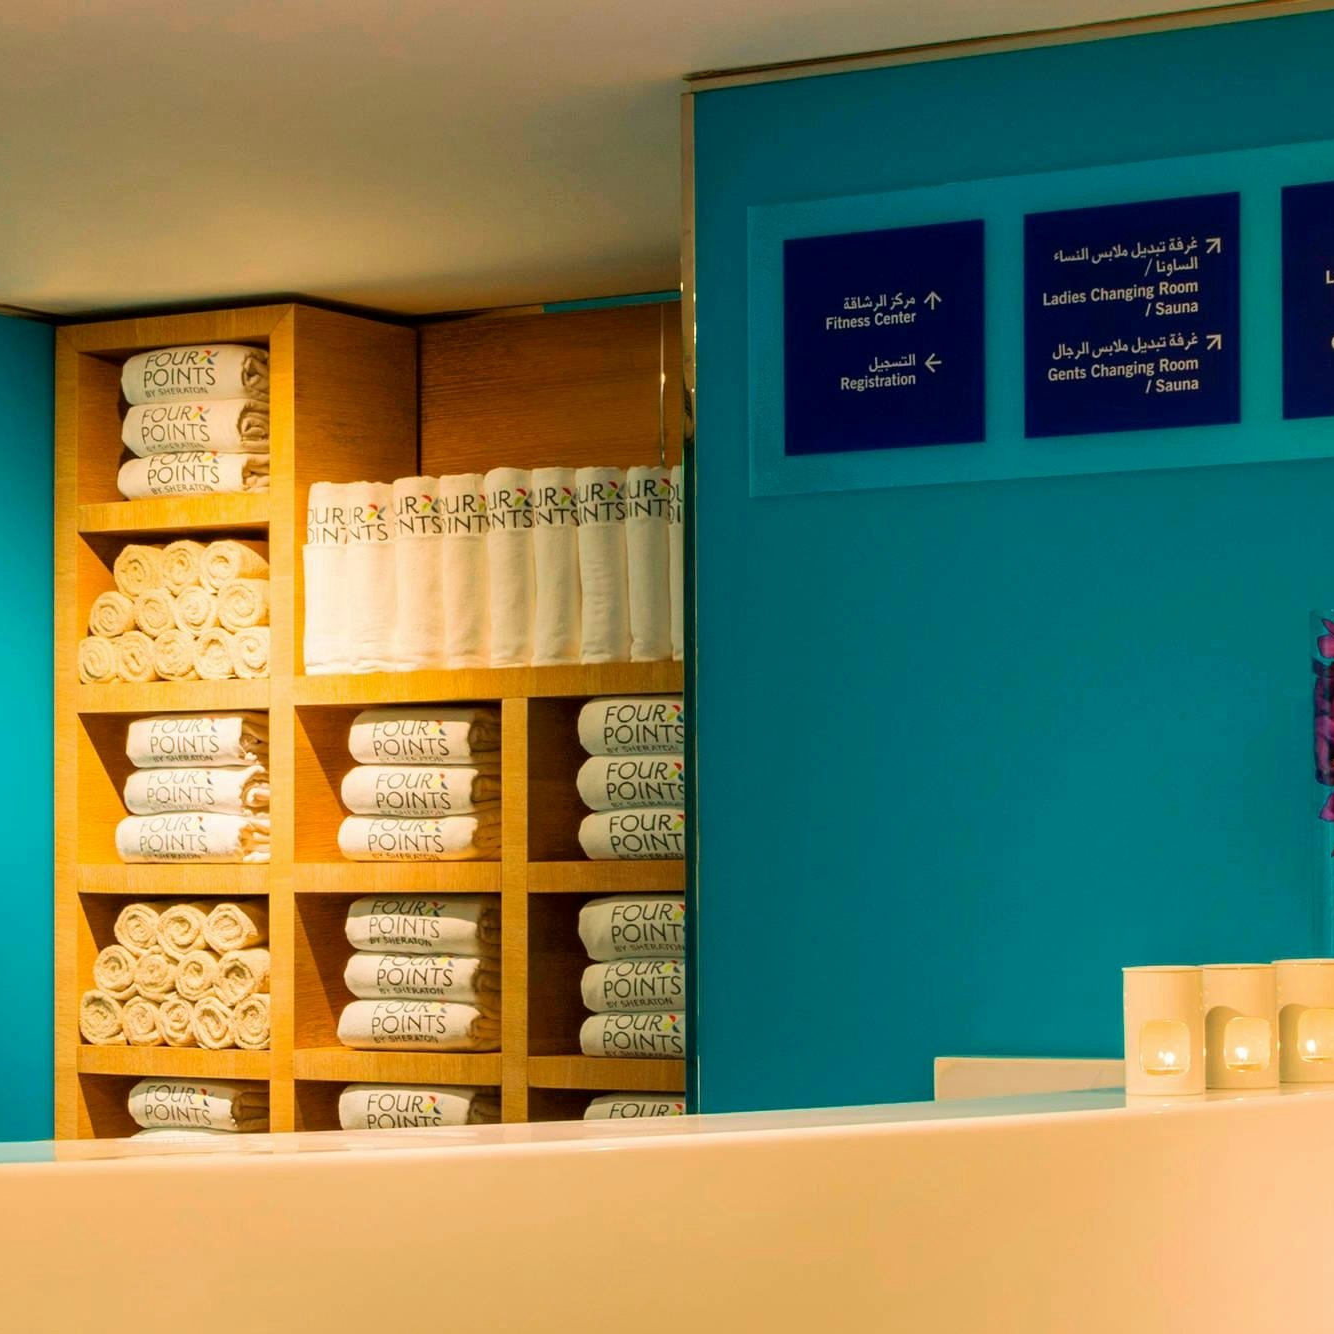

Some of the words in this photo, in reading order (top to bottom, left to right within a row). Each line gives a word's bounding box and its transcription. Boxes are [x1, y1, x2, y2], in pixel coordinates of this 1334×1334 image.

[1092, 244, 1128, 264] ملابس
[1131, 241, 1166, 258] تبديل
[1169, 236, 1198, 255] غرفة
[1054, 248, 1088, 262] النساء
[1157, 257, 1198, 276] الساونا
[844, 294, 886, 312] الرشاقة
[890, 292, 915, 310] مركز
[1043, 291, 1086, 306] Ladies
[1091, 285, 1154, 301] Changing
[1159, 282, 1198, 295] Room
[1156, 302, 1198, 315] Sauna
[826, 316, 870, 330] Fitness
[875, 311, 917, 325] Center
[1092, 339, 1128, 358] ملابس
[1131, 337, 1166, 353] تبديل
[1169, 332, 1198, 350] غرفة
[145, 351, 199, 368] FOUR
[1052, 342, 1089, 360] الرجال
[869, 354, 915, 372] التسجيل
[1048, 368, 1086, 381] Gents
[1091, 361, 1154, 378] Changing
[1159, 359, 1198, 372] Room
[144, 367, 216, 388] POINTS
[841, 373, 915, 391] Registration
[1156, 379, 1199, 392] Sauna
[145, 390, 155, 398] BY
[159, 387, 208, 395] SHERATON
[142, 406, 192, 424] FOUR
[142, 424, 210, 444] POINTS
[150, 451, 205, 467] FOUR
[148, 465, 220, 485] POINTS
[151, 487, 161, 495] BY
[164, 484, 214, 493] SHERATON
[605, 704, 666, 724] FOUR
[151, 719, 203, 734] FOUR
[373, 720, 429, 738] FOUR
[150, 735, 220, 753] POINTS
[373, 738, 449, 756] POINTS
[148, 771, 201, 785] FOUR
[607, 761, 668, 780] FOUR
[376, 772, 433, 789] FOUR
[147, 787, 215, 805] POINTS
[376, 792, 451, 810] POINTS
[140, 816, 192, 833] FOUR
[369, 819, 426, 832] FOUR
[610, 814, 671, 833] FOUR
[140, 834, 208, 852] POINTS
[368, 834, 444, 853] POINTS
[610, 833, 683, 852] POINT
[371, 900, 426, 915] FOUR
[611, 903, 672, 923] FOUR
[370, 917, 440, 938] POINTS
[612, 923, 684, 944] POINT
[383, 937, 432, 947] SHERATON
[377, 968, 453, 987] POINTS
[605, 961, 665, 977] FOUR
[393, 987, 444, 995] SHERATON
[604, 976, 681, 998] POINTS
[373, 1000, 429, 1014] FOUR
[620, 998, 673, 1007] SHERATON
[371, 1015, 446, 1034] POINTS
[604, 1014, 663, 1032] FOUR
[389, 1035, 438, 1043] SHERATON
[603, 1032, 683, 1054] POINTS
[146, 1085, 195, 1104] FOUR
[367, 1094, 423, 1112] FOUR
[145, 1104, 211, 1125] POINTS
[609, 1103, 669, 1119] FOUR
